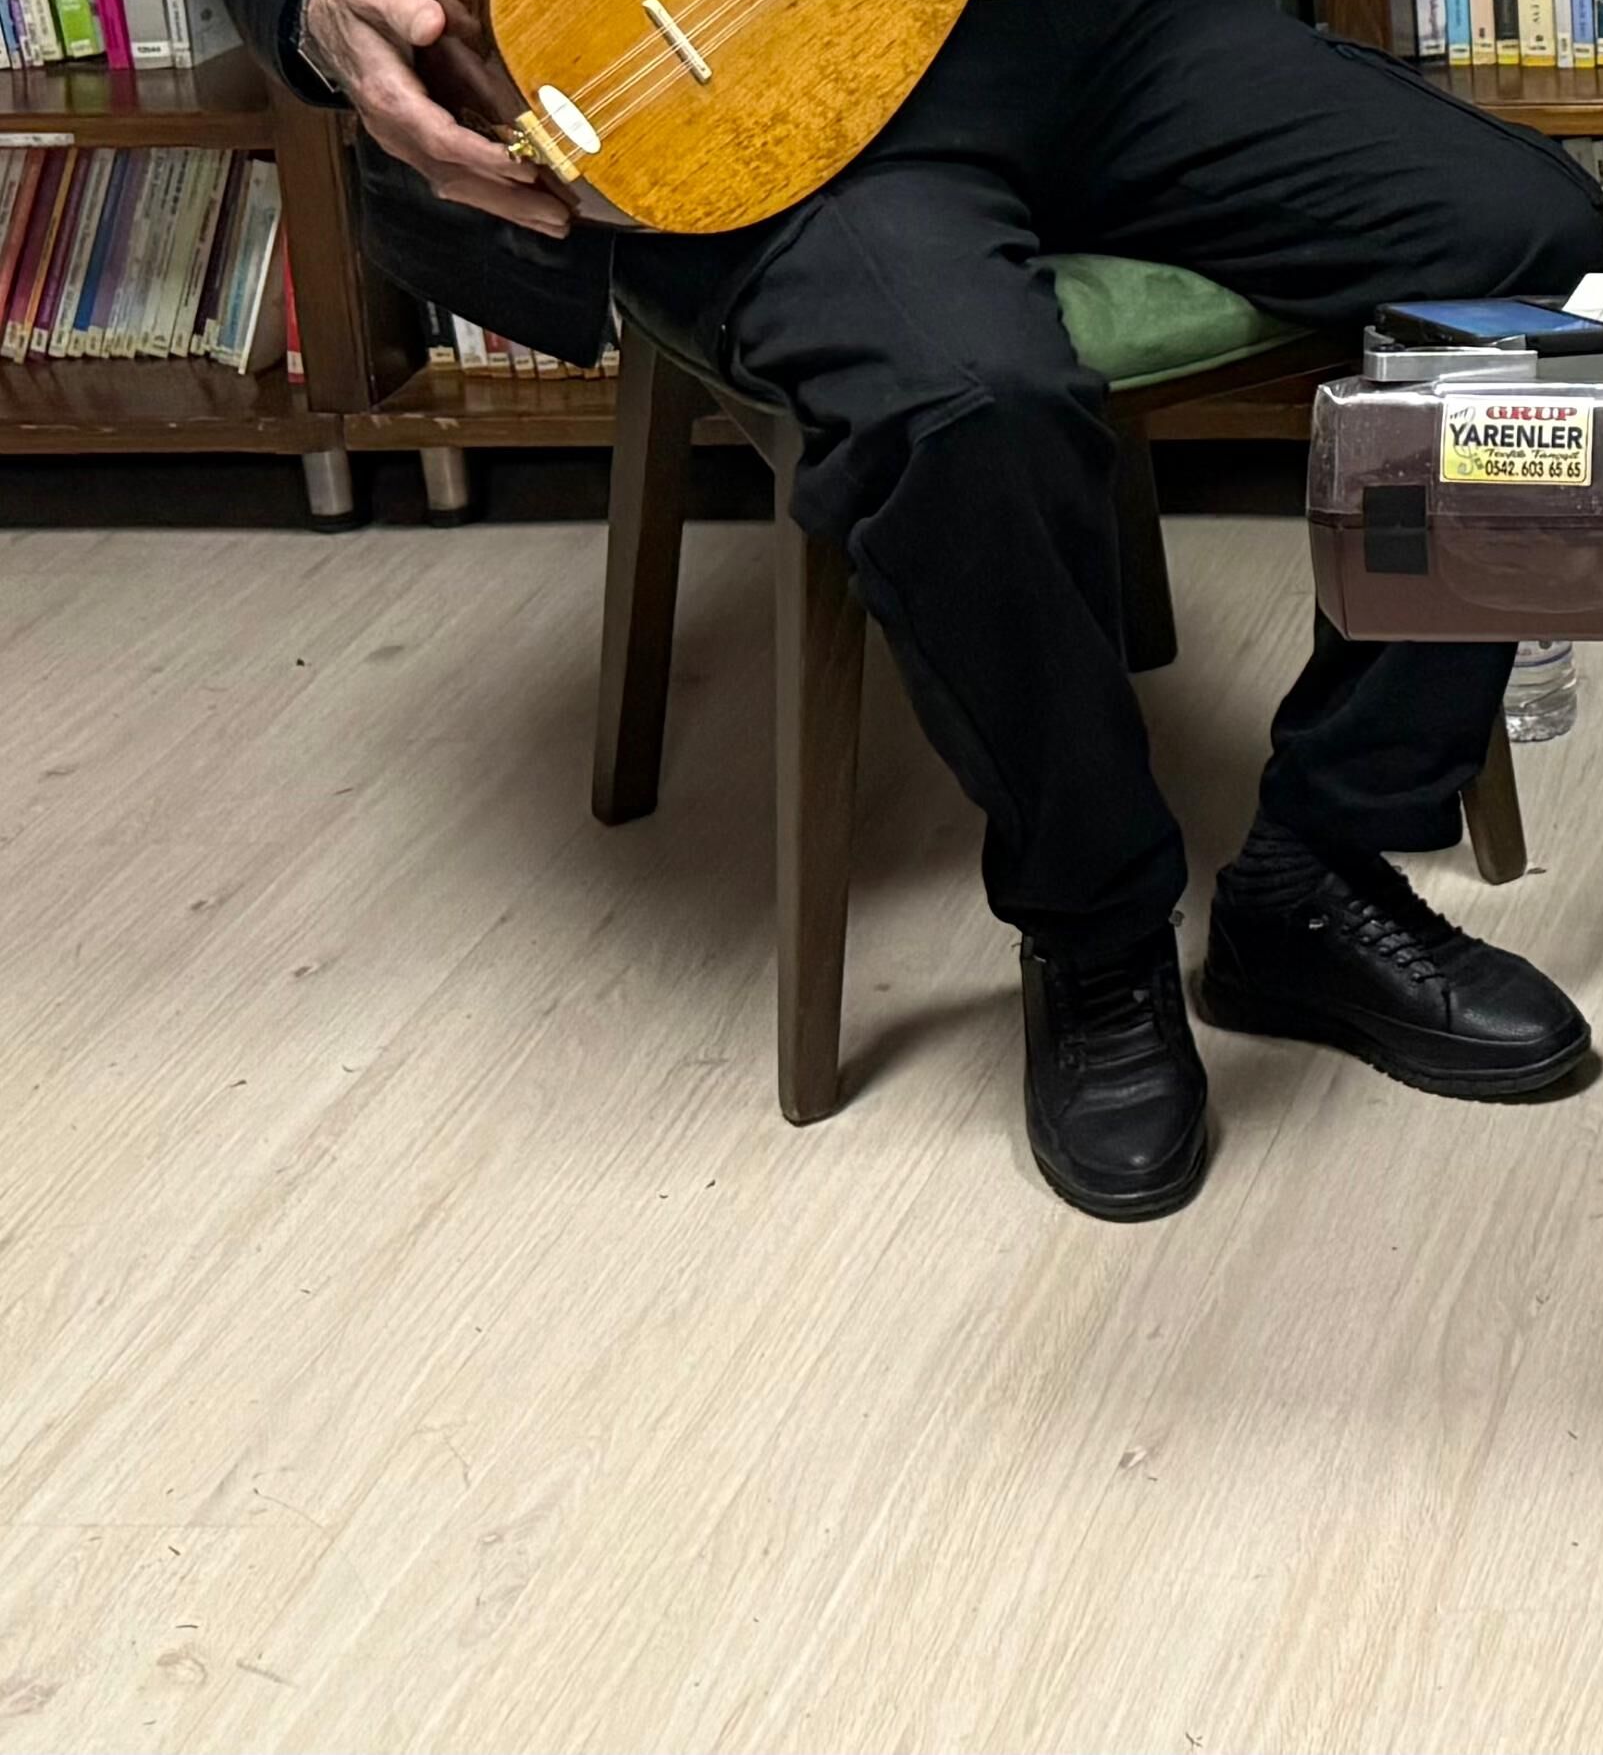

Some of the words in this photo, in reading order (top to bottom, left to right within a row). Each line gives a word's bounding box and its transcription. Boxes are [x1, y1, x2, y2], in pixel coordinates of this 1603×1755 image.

[1485, 405, 1578, 422] GRUP
[1449, 422, 1584, 450] YARENLER
[1521, 459, 1545, 479] 603
[1549, 460, 1564, 479] 65
[1566, 460, 1582, 479] 65
